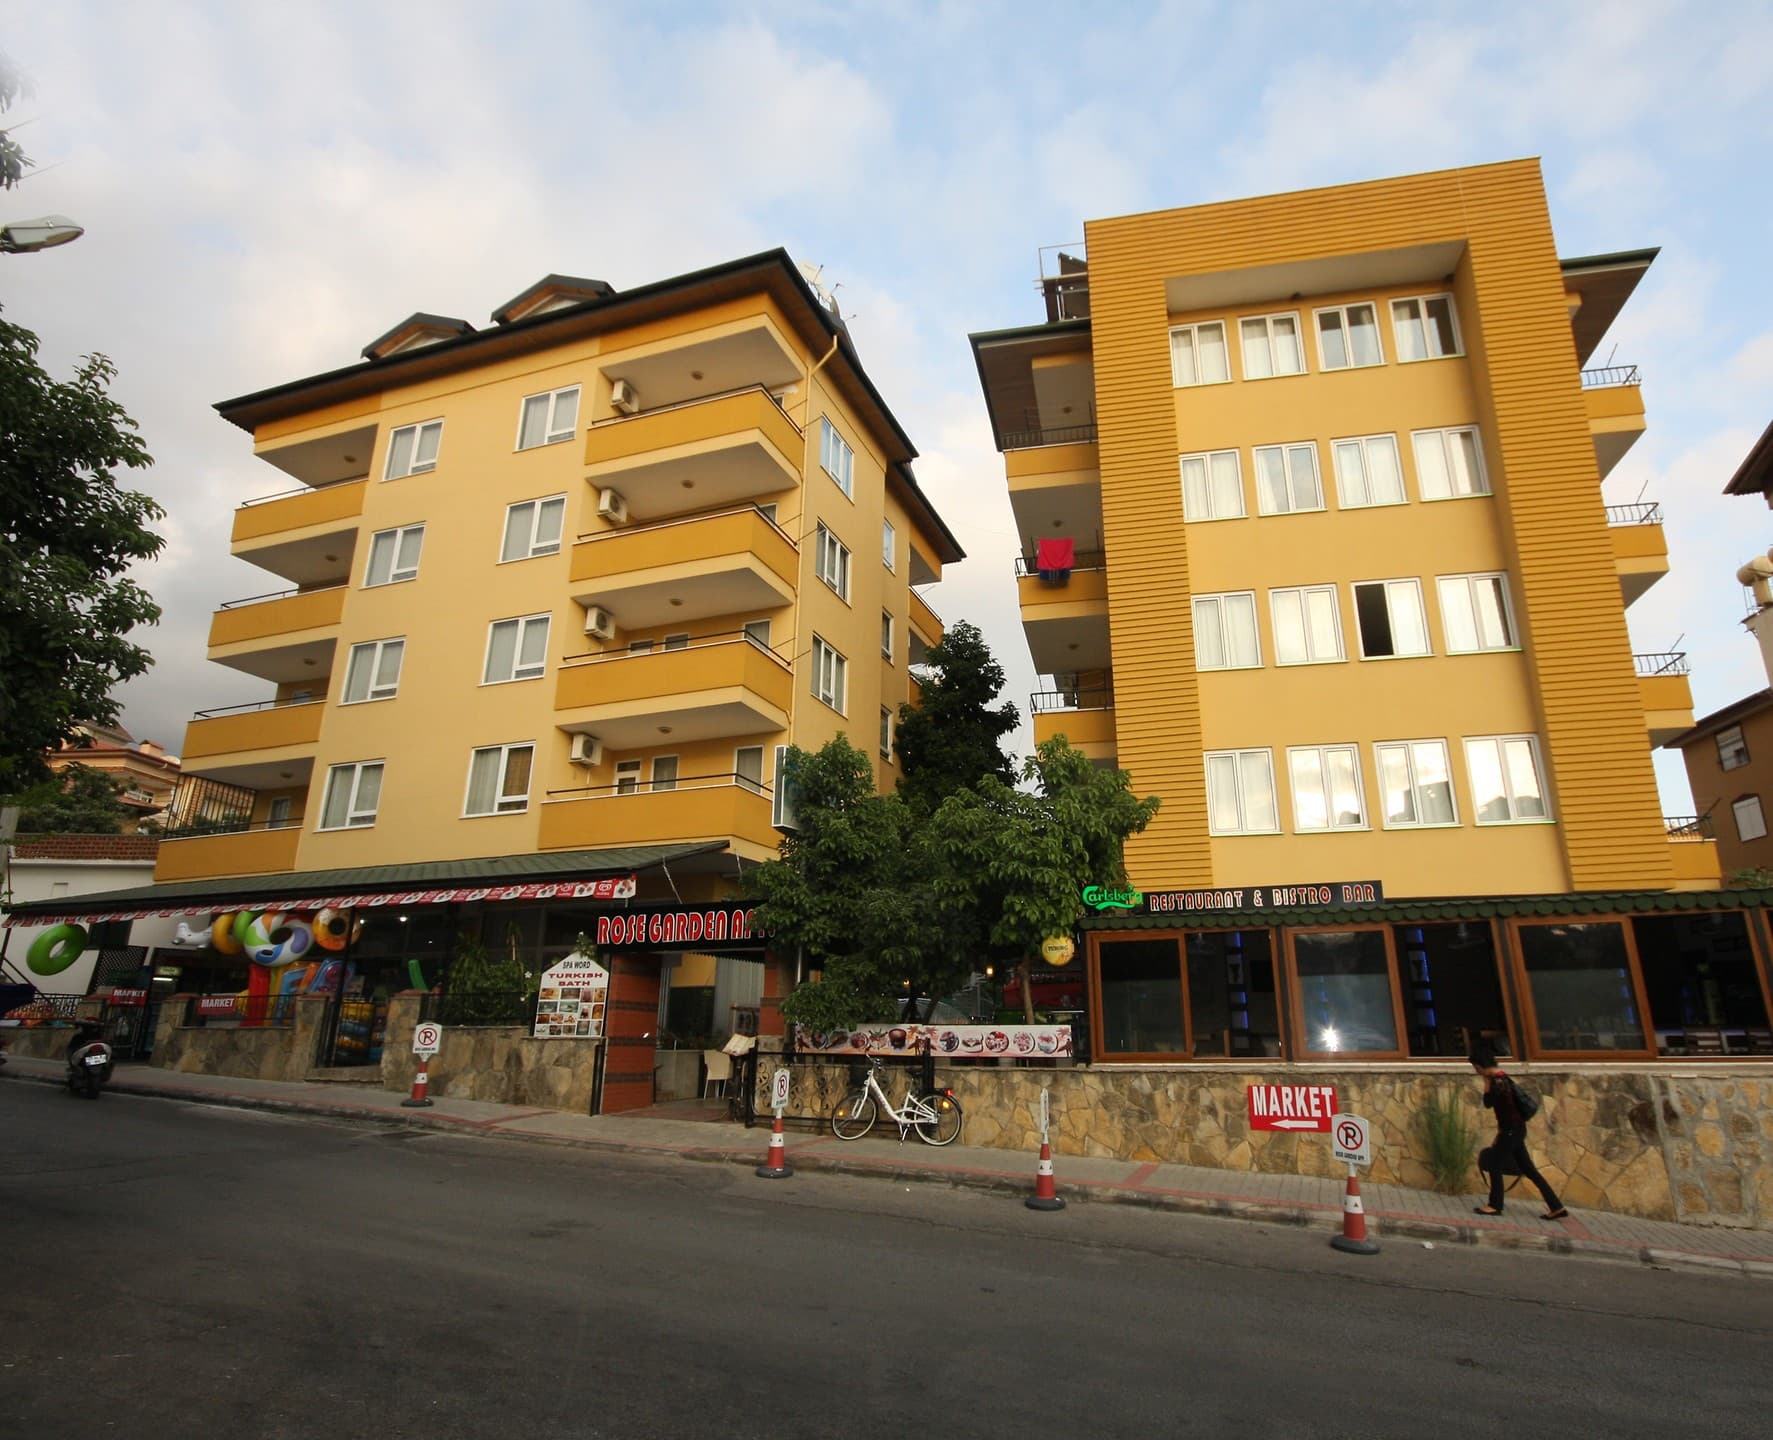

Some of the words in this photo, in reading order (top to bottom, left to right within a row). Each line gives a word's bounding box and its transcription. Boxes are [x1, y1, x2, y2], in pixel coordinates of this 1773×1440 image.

[1082, 884, 1143, 907] Carlsberg
[1150, 890, 1243, 912] RESTAURANT
[1253, 888, 1263, 907] &
[1272, 886, 1332, 907] BISTRO
[1342, 884, 1375, 904] BAR
[597, 914, 647, 945] ROSE
[648, 910, 728, 944] GARDEN
[562, 960, 573, 969] SPA
[574, 960, 591, 969] WORD
[201, 998, 234, 1008] MARKET
[1251, 1085, 1333, 1117] MARKET
